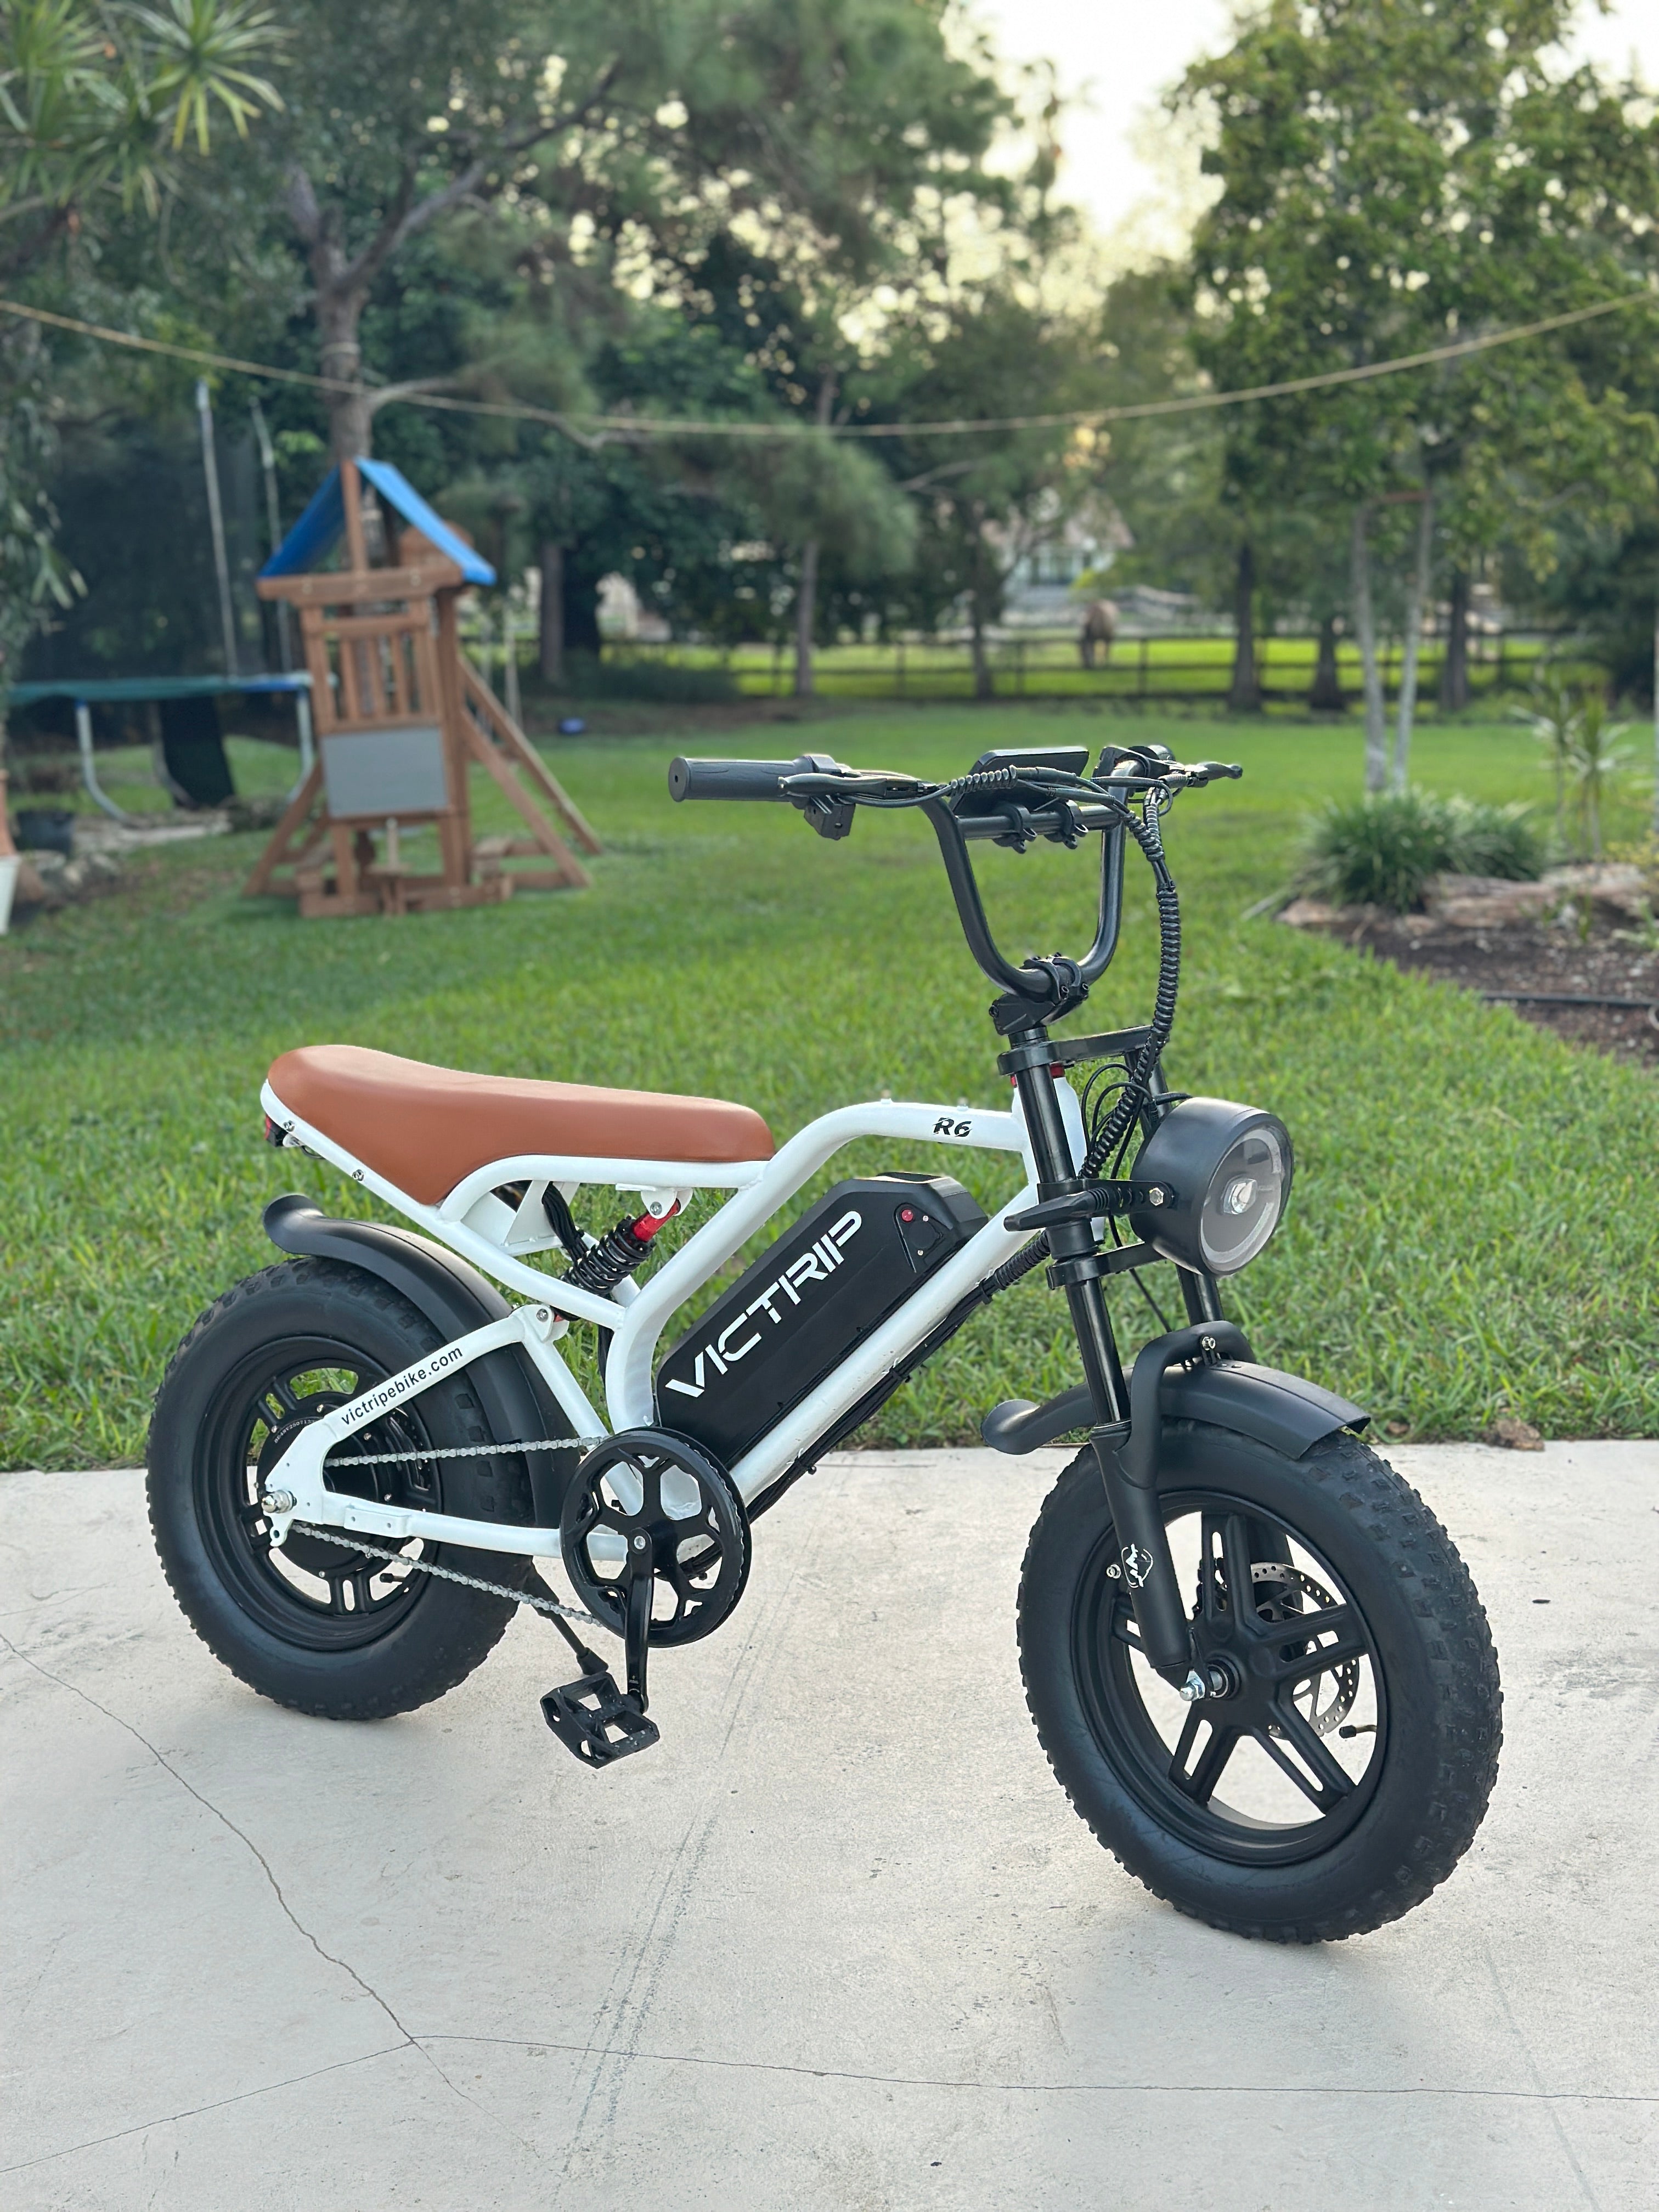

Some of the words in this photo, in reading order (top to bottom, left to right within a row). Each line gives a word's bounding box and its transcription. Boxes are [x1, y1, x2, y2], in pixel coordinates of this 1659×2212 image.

[932, 1116, 973, 1137] R6
[665, 1211, 862, 1397] VICTRIP
[341, 1347, 463, 1425] victripebike.com
